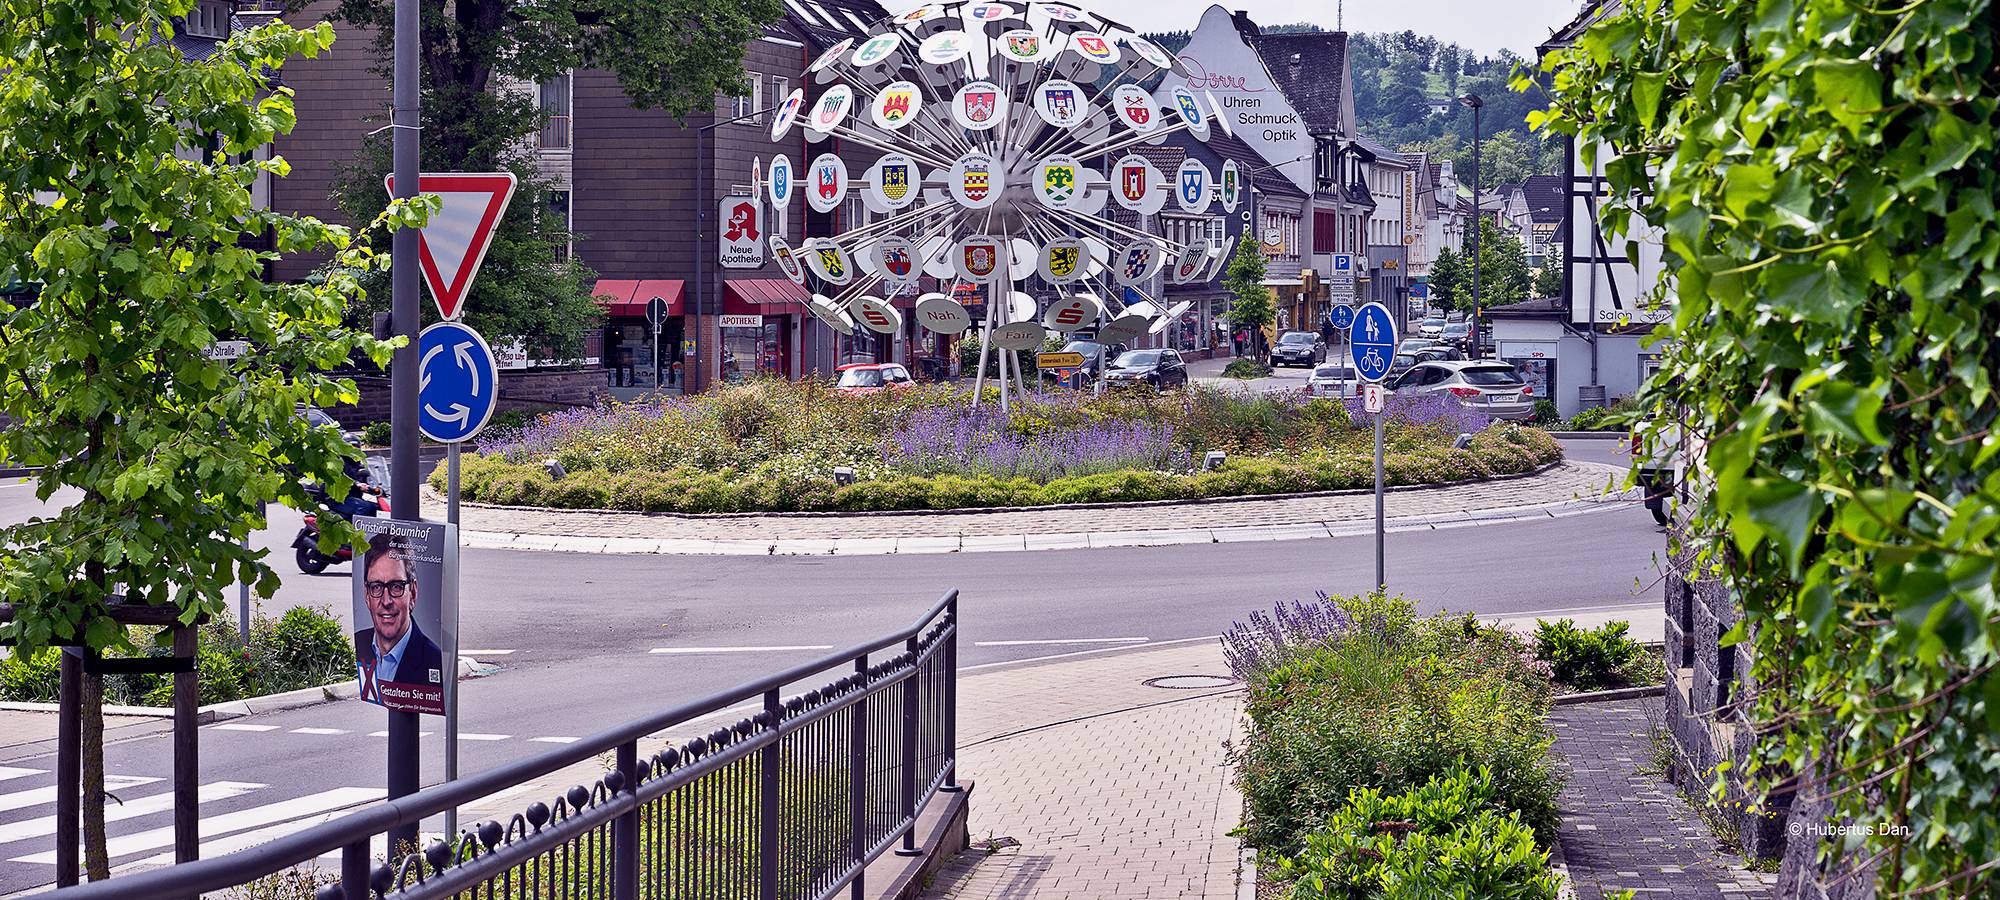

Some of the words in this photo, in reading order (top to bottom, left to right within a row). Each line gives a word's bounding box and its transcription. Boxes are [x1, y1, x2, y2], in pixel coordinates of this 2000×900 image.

[1223, 96, 1261, 108] Uhren
[1238, 112, 1297, 124] Schmuck
[1262, 129, 1297, 141] Optik
[960, 155, 992, 165] Bergneustadt
[1405, 173, 1413, 231] COMMERZBANK
[729, 245, 753, 254] Neue
[720, 254, 762, 264] Apotheke
[1338, 257, 1347, 268] P
[927, 311, 960, 321] Nah.
[1599, 310, 1633, 320] Salon
[721, 316, 757, 325] APOTHEKE
[1005, 331, 1034, 339] Fair.
[214, 345, 236, 357] Straße
[354, 519, 388, 535] Christian
[389, 523, 432, 542] Baumhof
[388, 540, 397, 548] der
[380, 684, 411, 699] Gestalten
[412, 689, 424, 700] Sie
[425, 691, 441, 702] mit!
